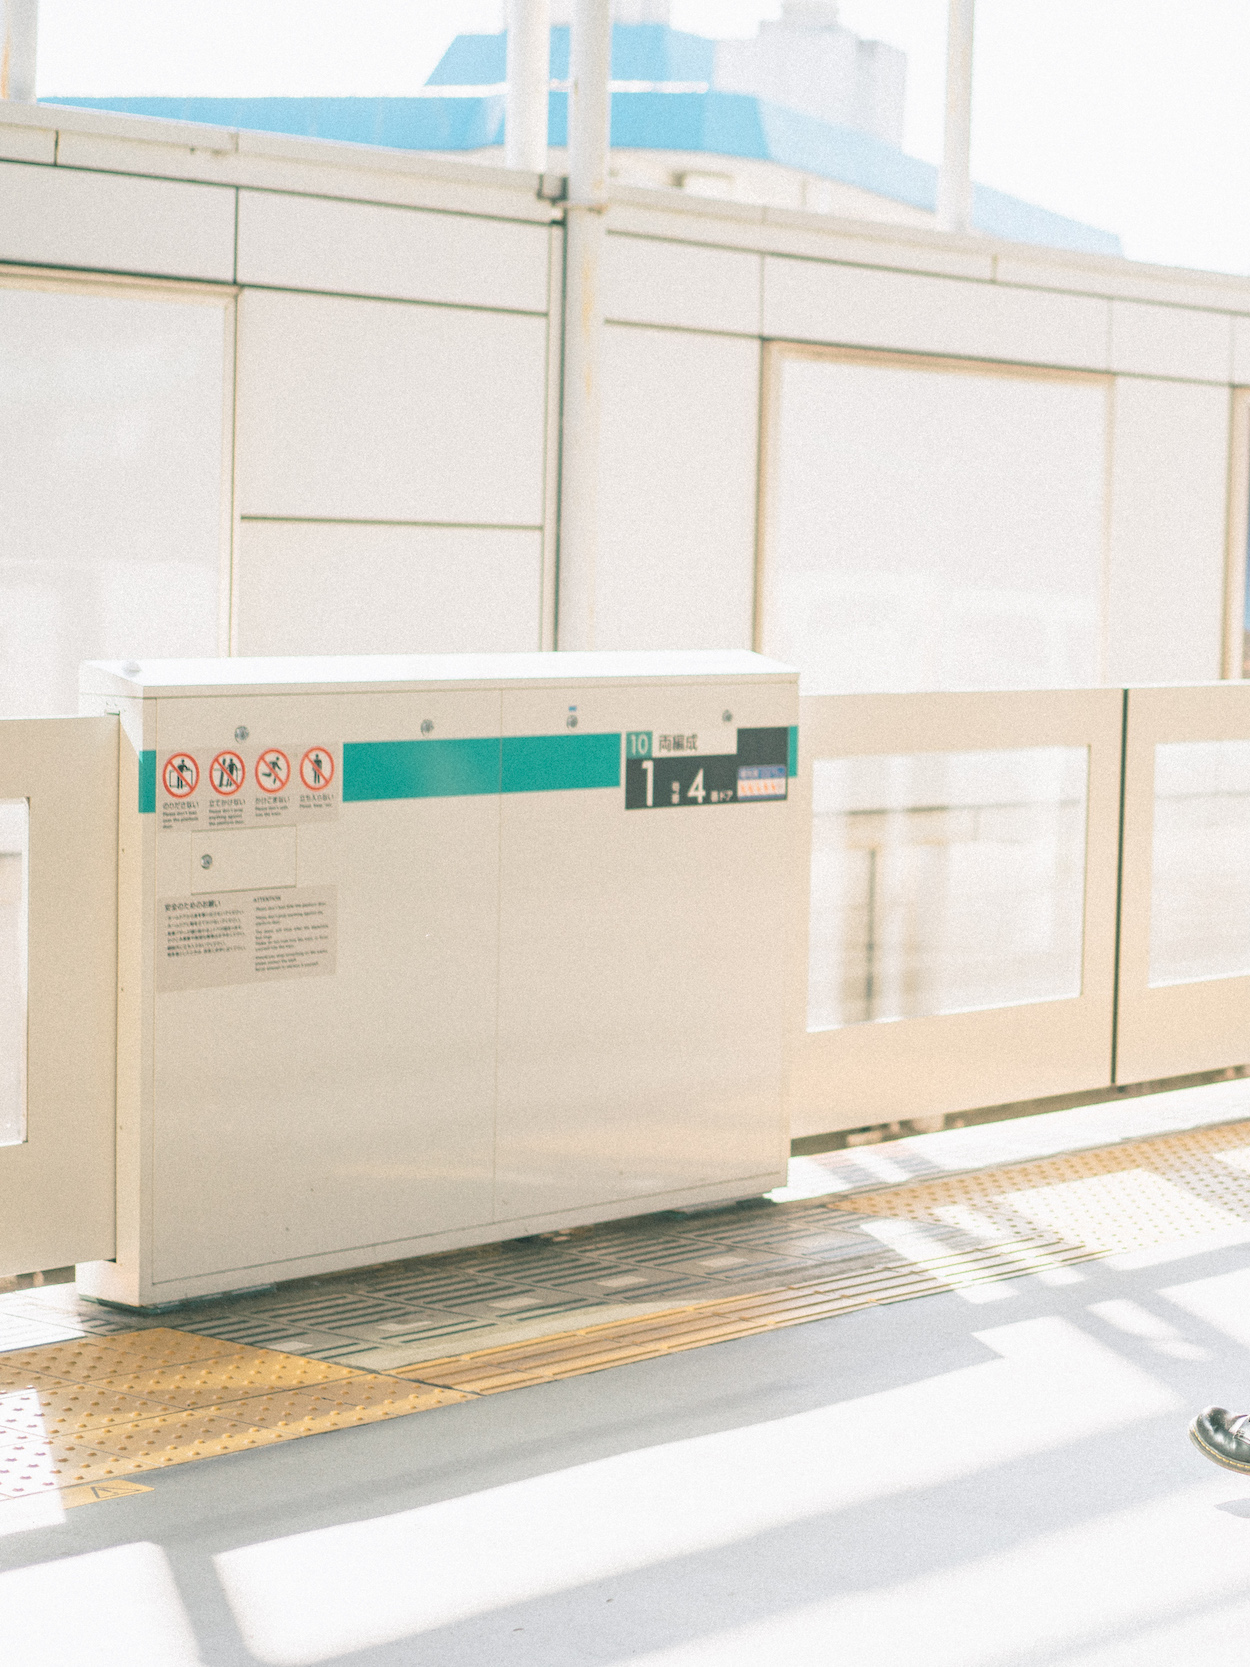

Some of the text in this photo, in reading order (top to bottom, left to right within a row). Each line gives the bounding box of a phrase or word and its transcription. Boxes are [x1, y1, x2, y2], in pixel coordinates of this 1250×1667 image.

[631, 734, 698, 755] 10 両編成
[642, 760, 654, 807] 1
[687, 768, 706, 804] 4
